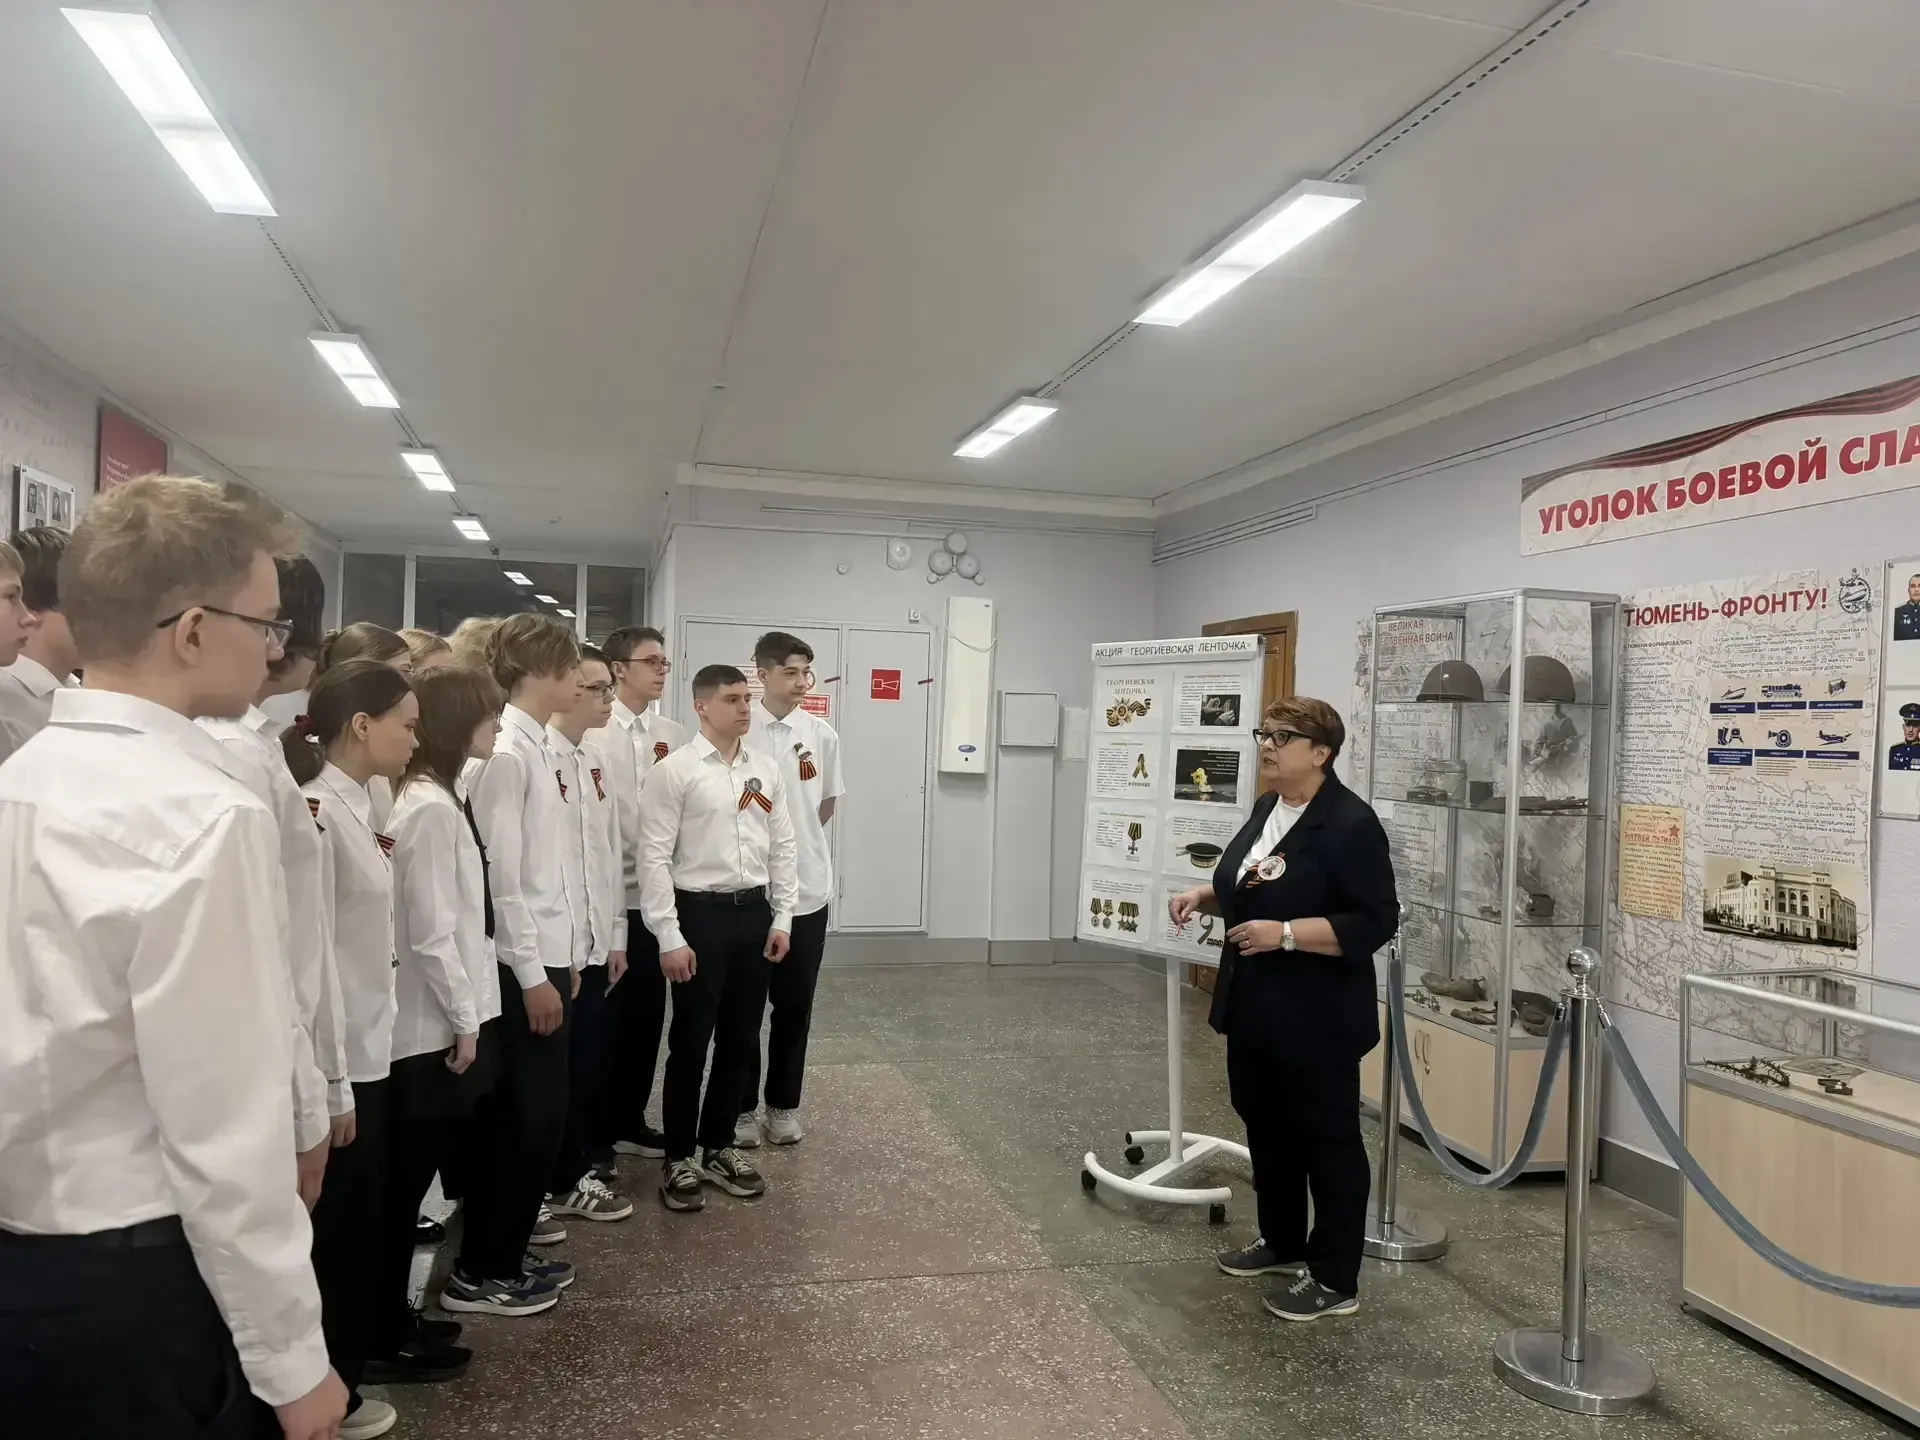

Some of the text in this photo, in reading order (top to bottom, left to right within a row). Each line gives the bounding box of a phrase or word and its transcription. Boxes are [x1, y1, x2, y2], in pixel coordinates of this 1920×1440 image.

[1538, 482, 1659, 535] УГОЛОК
[1666, 436, 1828, 510] БОЕВОЙ
[1623, 588, 1828, 628] ТЮМЕНЬ-ФРОНТУ!
[1388, 619, 1424, 632] ВЕЛИКАЯ
[1362, 630, 1454, 648] ОТЕСТВЕННАЯ ВОЙНА
[1095, 647, 1123, 658] АКЦИЯ
